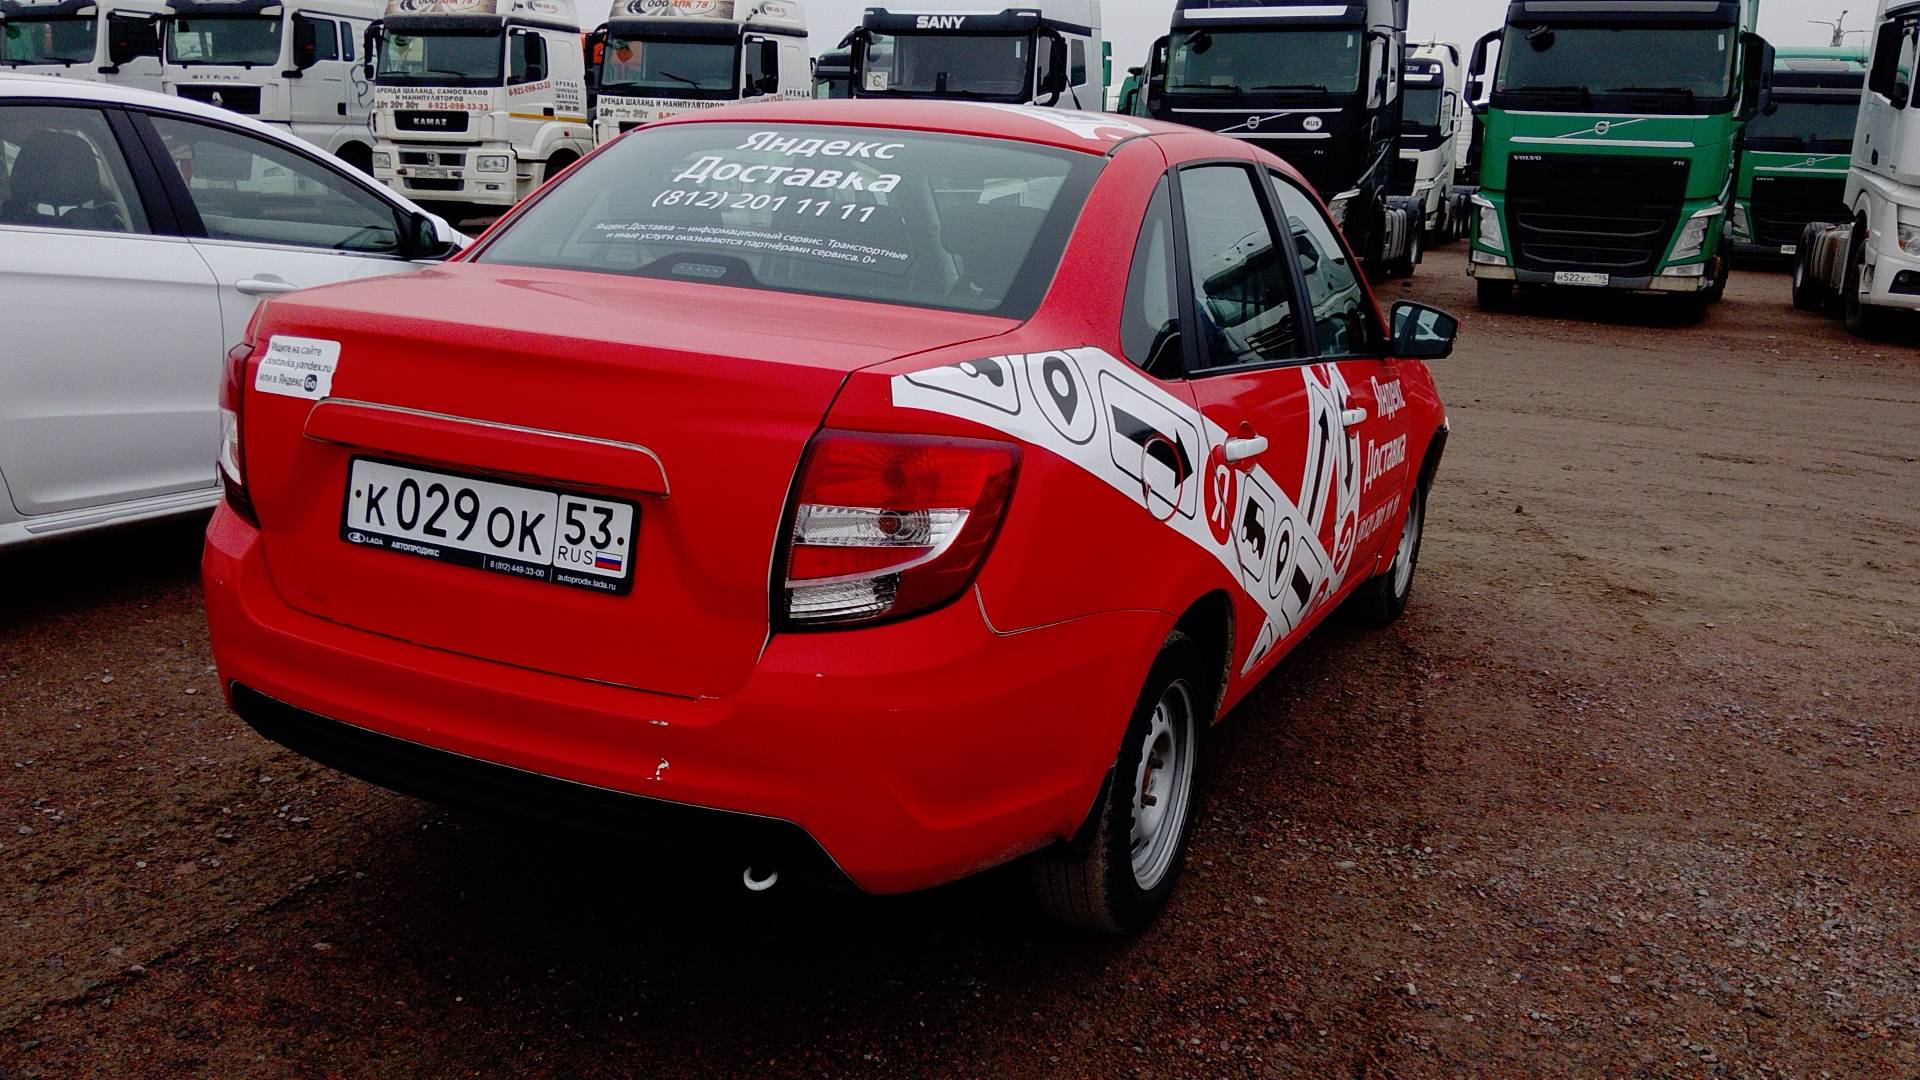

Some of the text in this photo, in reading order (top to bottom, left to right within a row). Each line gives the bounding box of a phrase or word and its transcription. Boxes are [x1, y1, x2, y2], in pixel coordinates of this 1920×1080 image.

[916, 16, 965, 29] SANY
[437, 88, 488, 96] САМОСВАЛОВ
[785, 88, 810, 99] АРЕНДА
[427, 102, 489, 111] 8-921-098-33-33
[599, 97, 625, 106] АРЕНДА
[625, 98, 654, 107] ШАЛАНД
[413, 117, 447, 126] KAMAZ
[736, 131, 905, 160] Яндекс
[673, 156, 901, 193] Доставка
[651, 189, 875, 223] (812) 201 11 11
[638, 233, 675, 241] услуги
[675, 234, 742, 246] оказываются
[743, 239, 810, 254] партнёрами
[811, 248, 860, 263] сервиса.
[686, 225, 782, 240] информационный
[783, 234, 824, 246] сервис.
[828, 239, 909, 261] Транспортные
[272, 342, 322, 357] Ищите на сайте
[260, 373, 272, 383] или
[279, 373, 303, 388] Яндекс
[305, 376, 317, 390] Go
[1370, 375, 1406, 420] Яндекс
[1362, 433, 1407, 494] Доставка
[365, 478, 614, 556] К029ОК 53
[365, 536, 384, 546] LADA
[391, 541, 440, 557] АВТОПРОДИКС
[558, 545, 593, 565] RUS
[490, 560, 545, 578] 8 (812) 449-33-00
[557, 574, 617, 590] autoprodix.lada.ru
